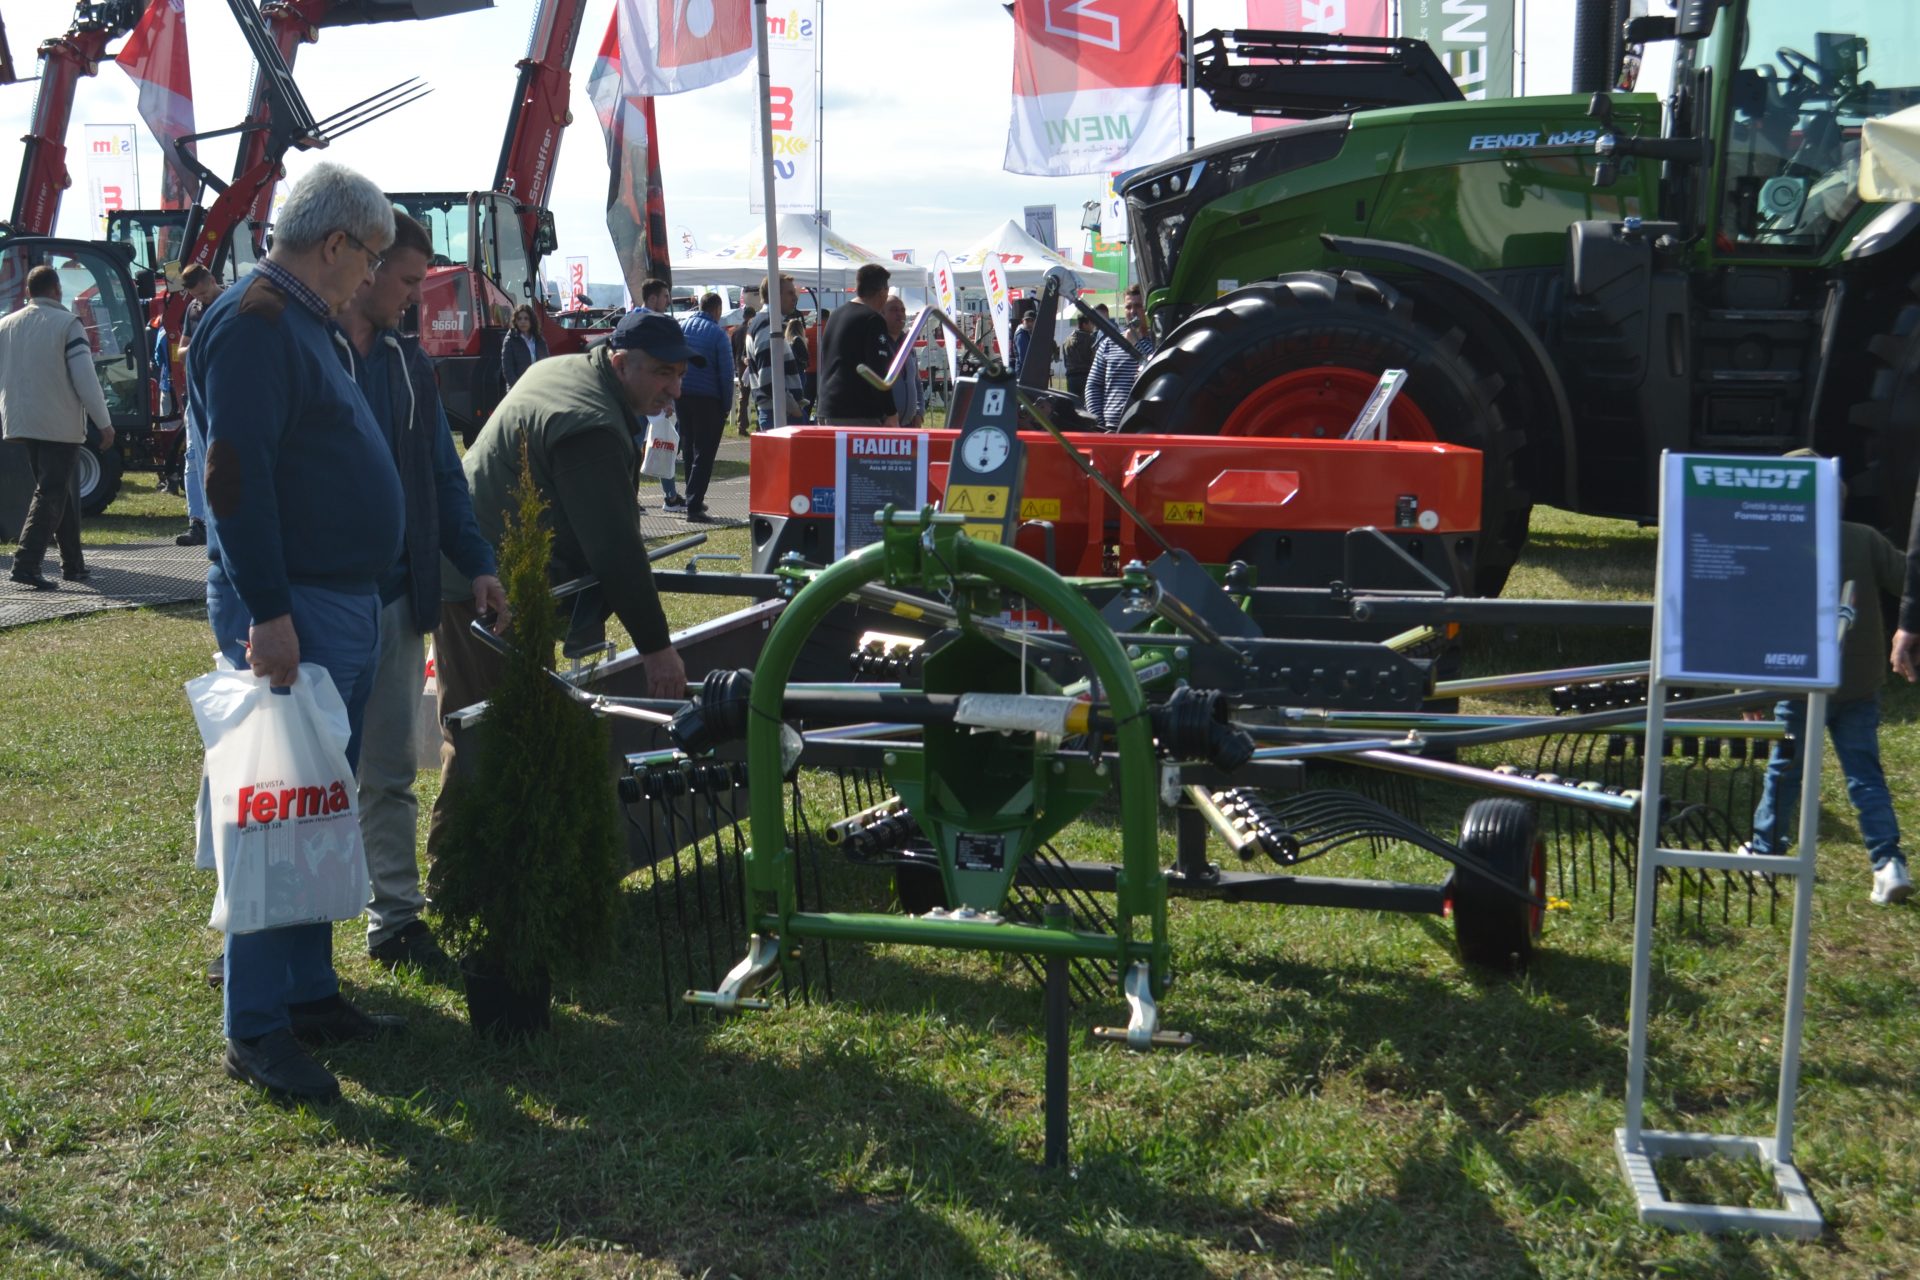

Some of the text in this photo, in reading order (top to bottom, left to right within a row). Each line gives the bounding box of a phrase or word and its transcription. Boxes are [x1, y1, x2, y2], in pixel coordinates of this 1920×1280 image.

[1469, 130, 1597, 150] FENDT 1042
[853, 438, 912, 455] RAUCH
[1692, 466, 1809, 489] FENDT
[1734, 512, 1769, 521] Former
[1764, 653, 1808, 666] MEWI
[256, 780, 285, 789] REVISTA
[238, 780, 350, 829] Ferma
